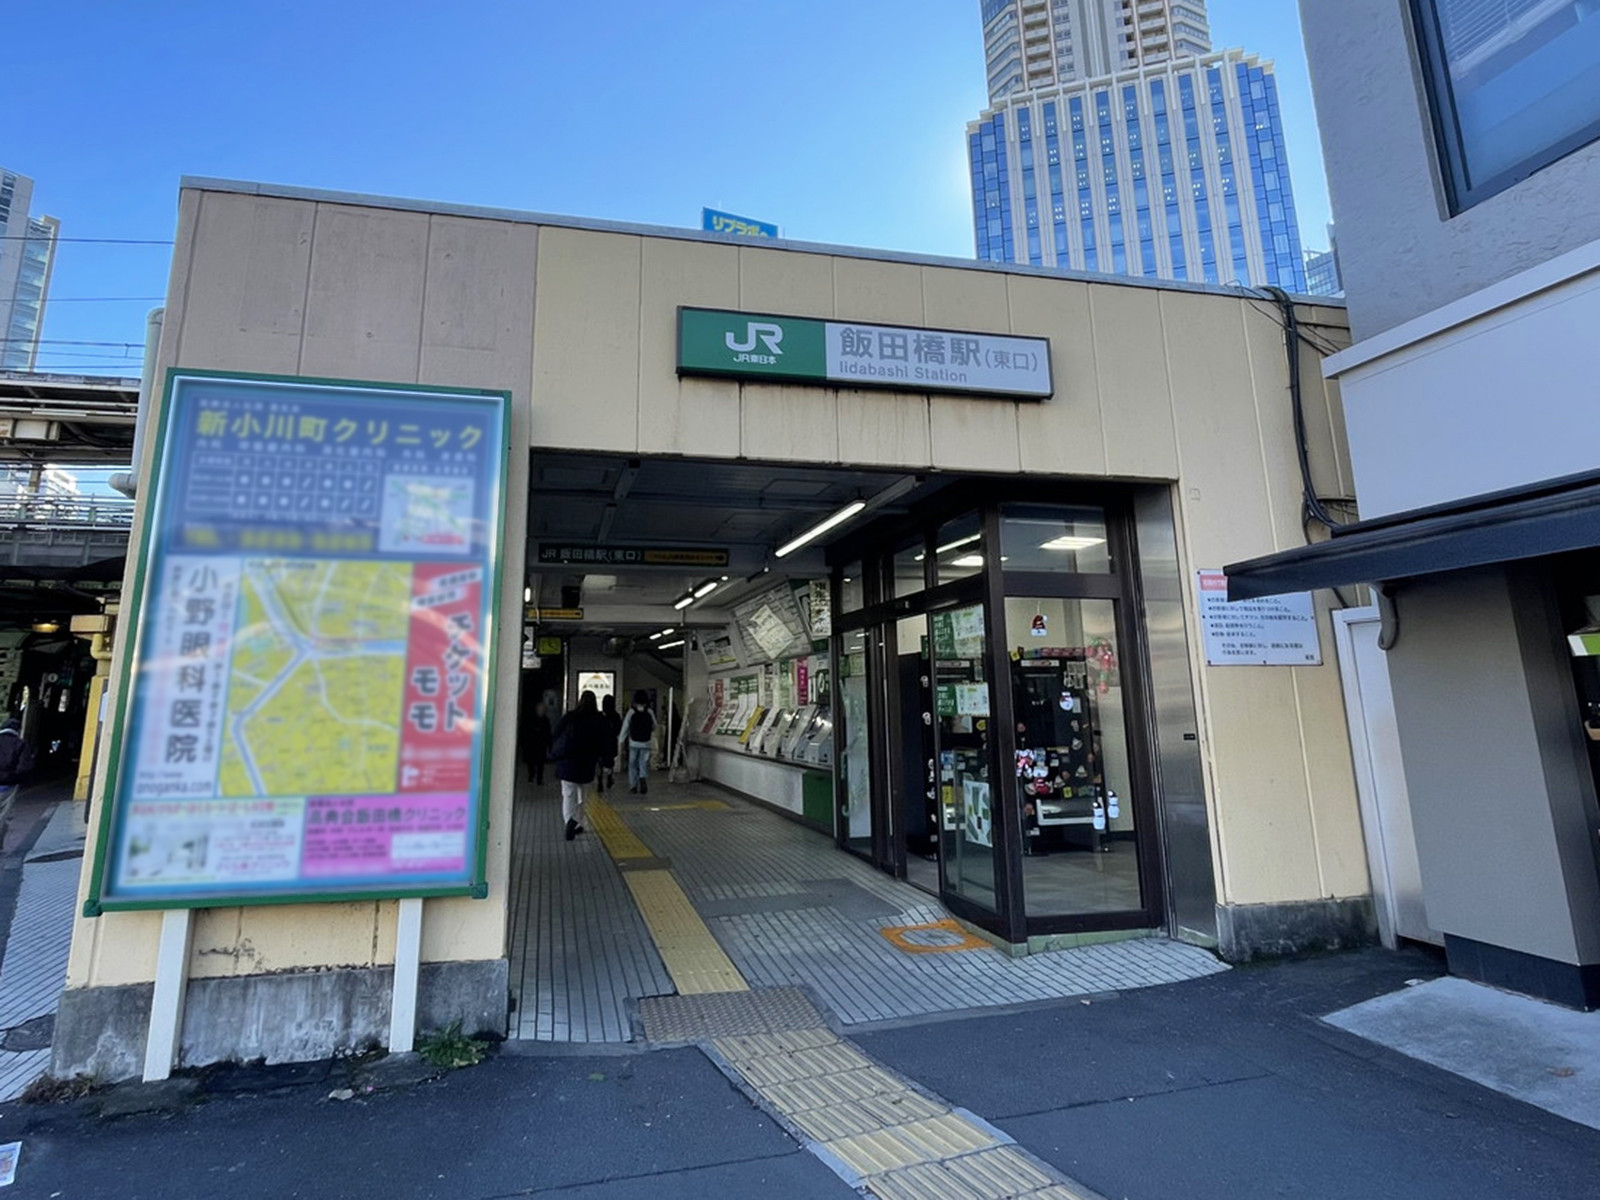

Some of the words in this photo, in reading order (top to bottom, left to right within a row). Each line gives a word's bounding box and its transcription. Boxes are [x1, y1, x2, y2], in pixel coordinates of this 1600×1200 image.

[725, 322, 783, 355] JR
[733, 352, 777, 365] JR東日本
[839, 361, 908, 379] Iidabashi
[914, 367, 966, 383] Station
[198, 410, 481, 449] 新小川町クリニック
[164, 565, 218, 764] 小野眼科医院
[410, 667, 438, 730] モモ
